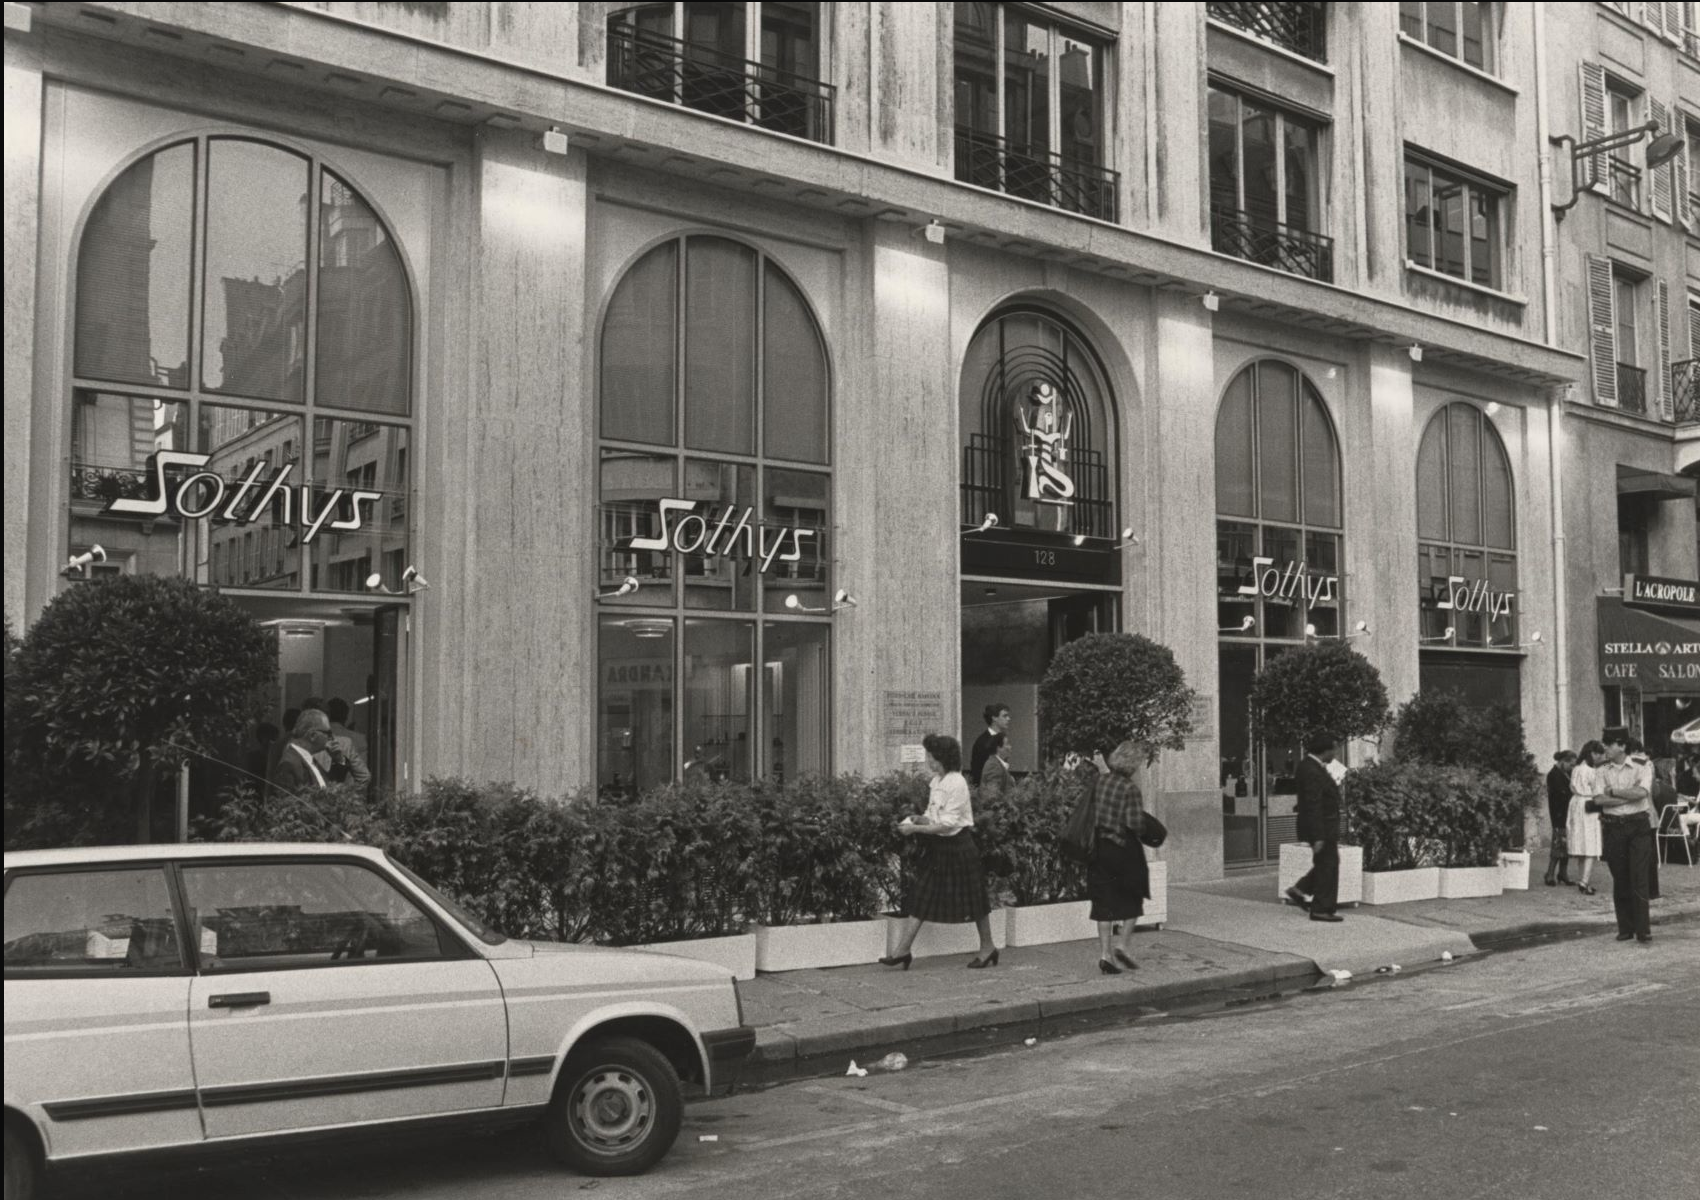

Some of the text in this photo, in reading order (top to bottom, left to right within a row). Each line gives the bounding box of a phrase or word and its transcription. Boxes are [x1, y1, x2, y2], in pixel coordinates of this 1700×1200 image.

[109, 450, 383, 543] Sothys
[629, 498, 815, 573] Sothys
[1034, 550, 1055, 566] 128
[1237, 556, 1338, 611] Sothys
[1437, 575, 1515, 623] Sothys
[1635, 580, 1696, 603] L'ACROPOLE
[1604, 642, 1700, 655] STELLA ART
